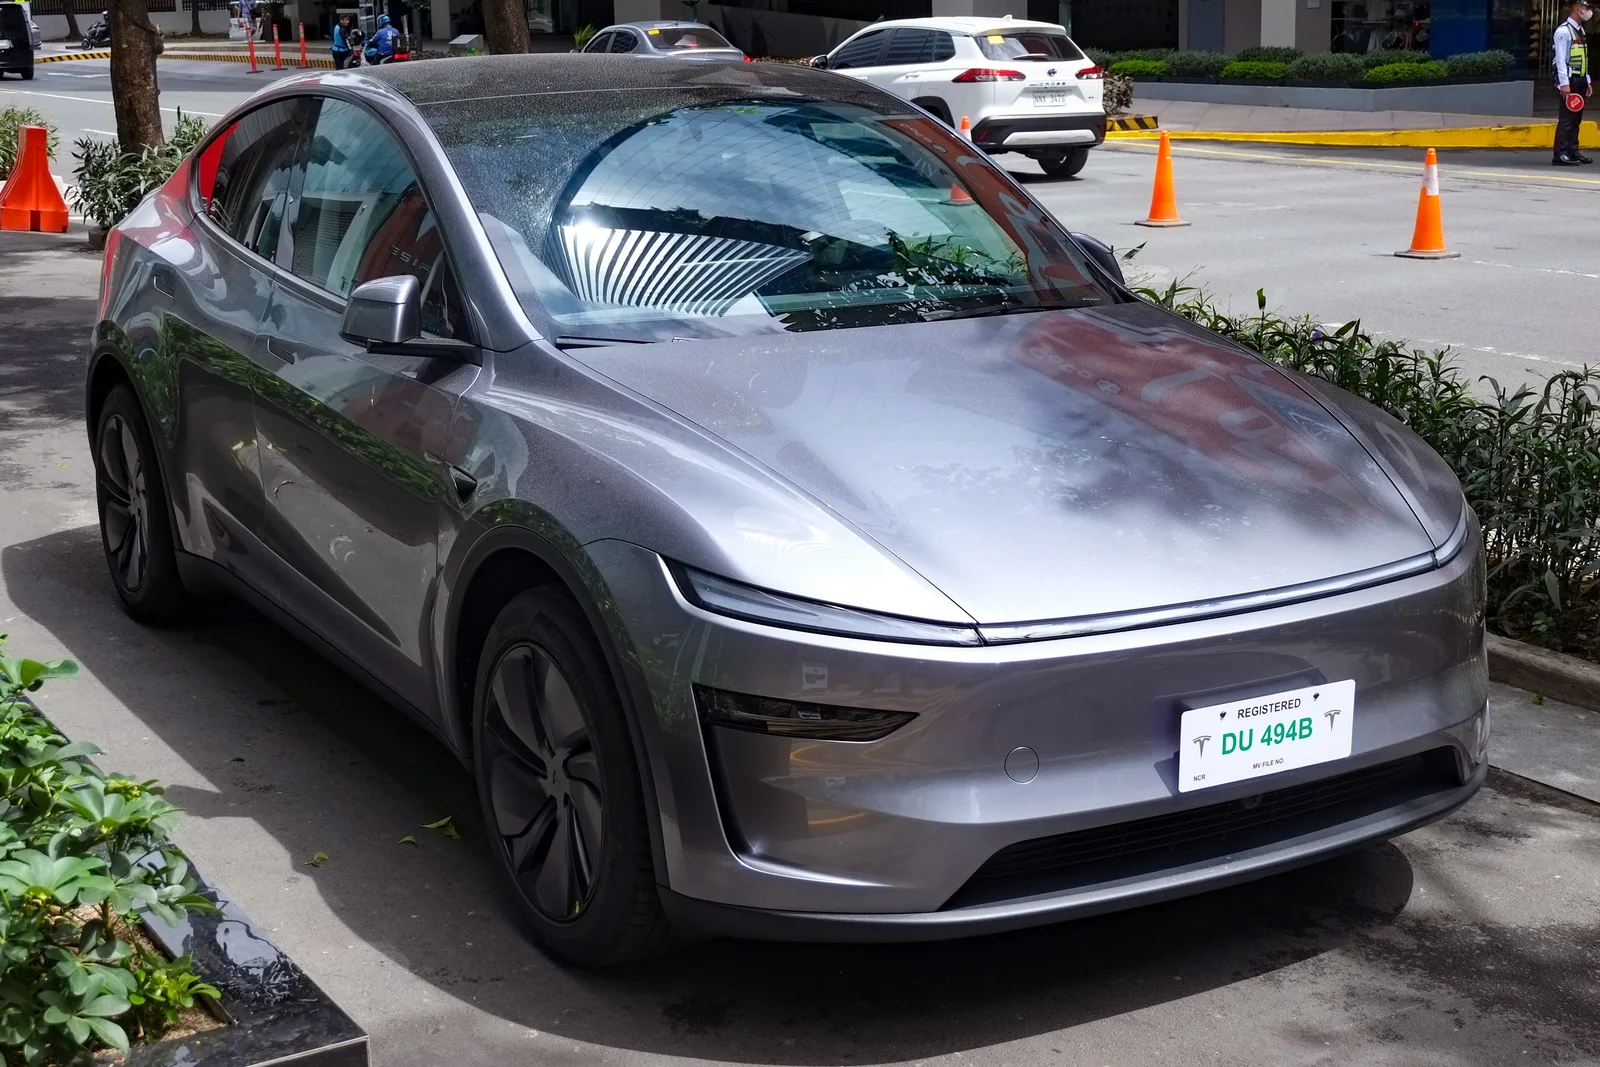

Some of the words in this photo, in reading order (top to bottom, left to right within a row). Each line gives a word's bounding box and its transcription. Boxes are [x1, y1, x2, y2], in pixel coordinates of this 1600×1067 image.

[1237, 698, 1301, 719] REGISTERED
[1221, 728, 1253, 755] DU
[1260, 717, 1313, 746] 494B
[1262, 759, 1274, 767] FILE
[1274, 757, 1284, 765] NO.
[1193, 774, 1206, 782] NCR
